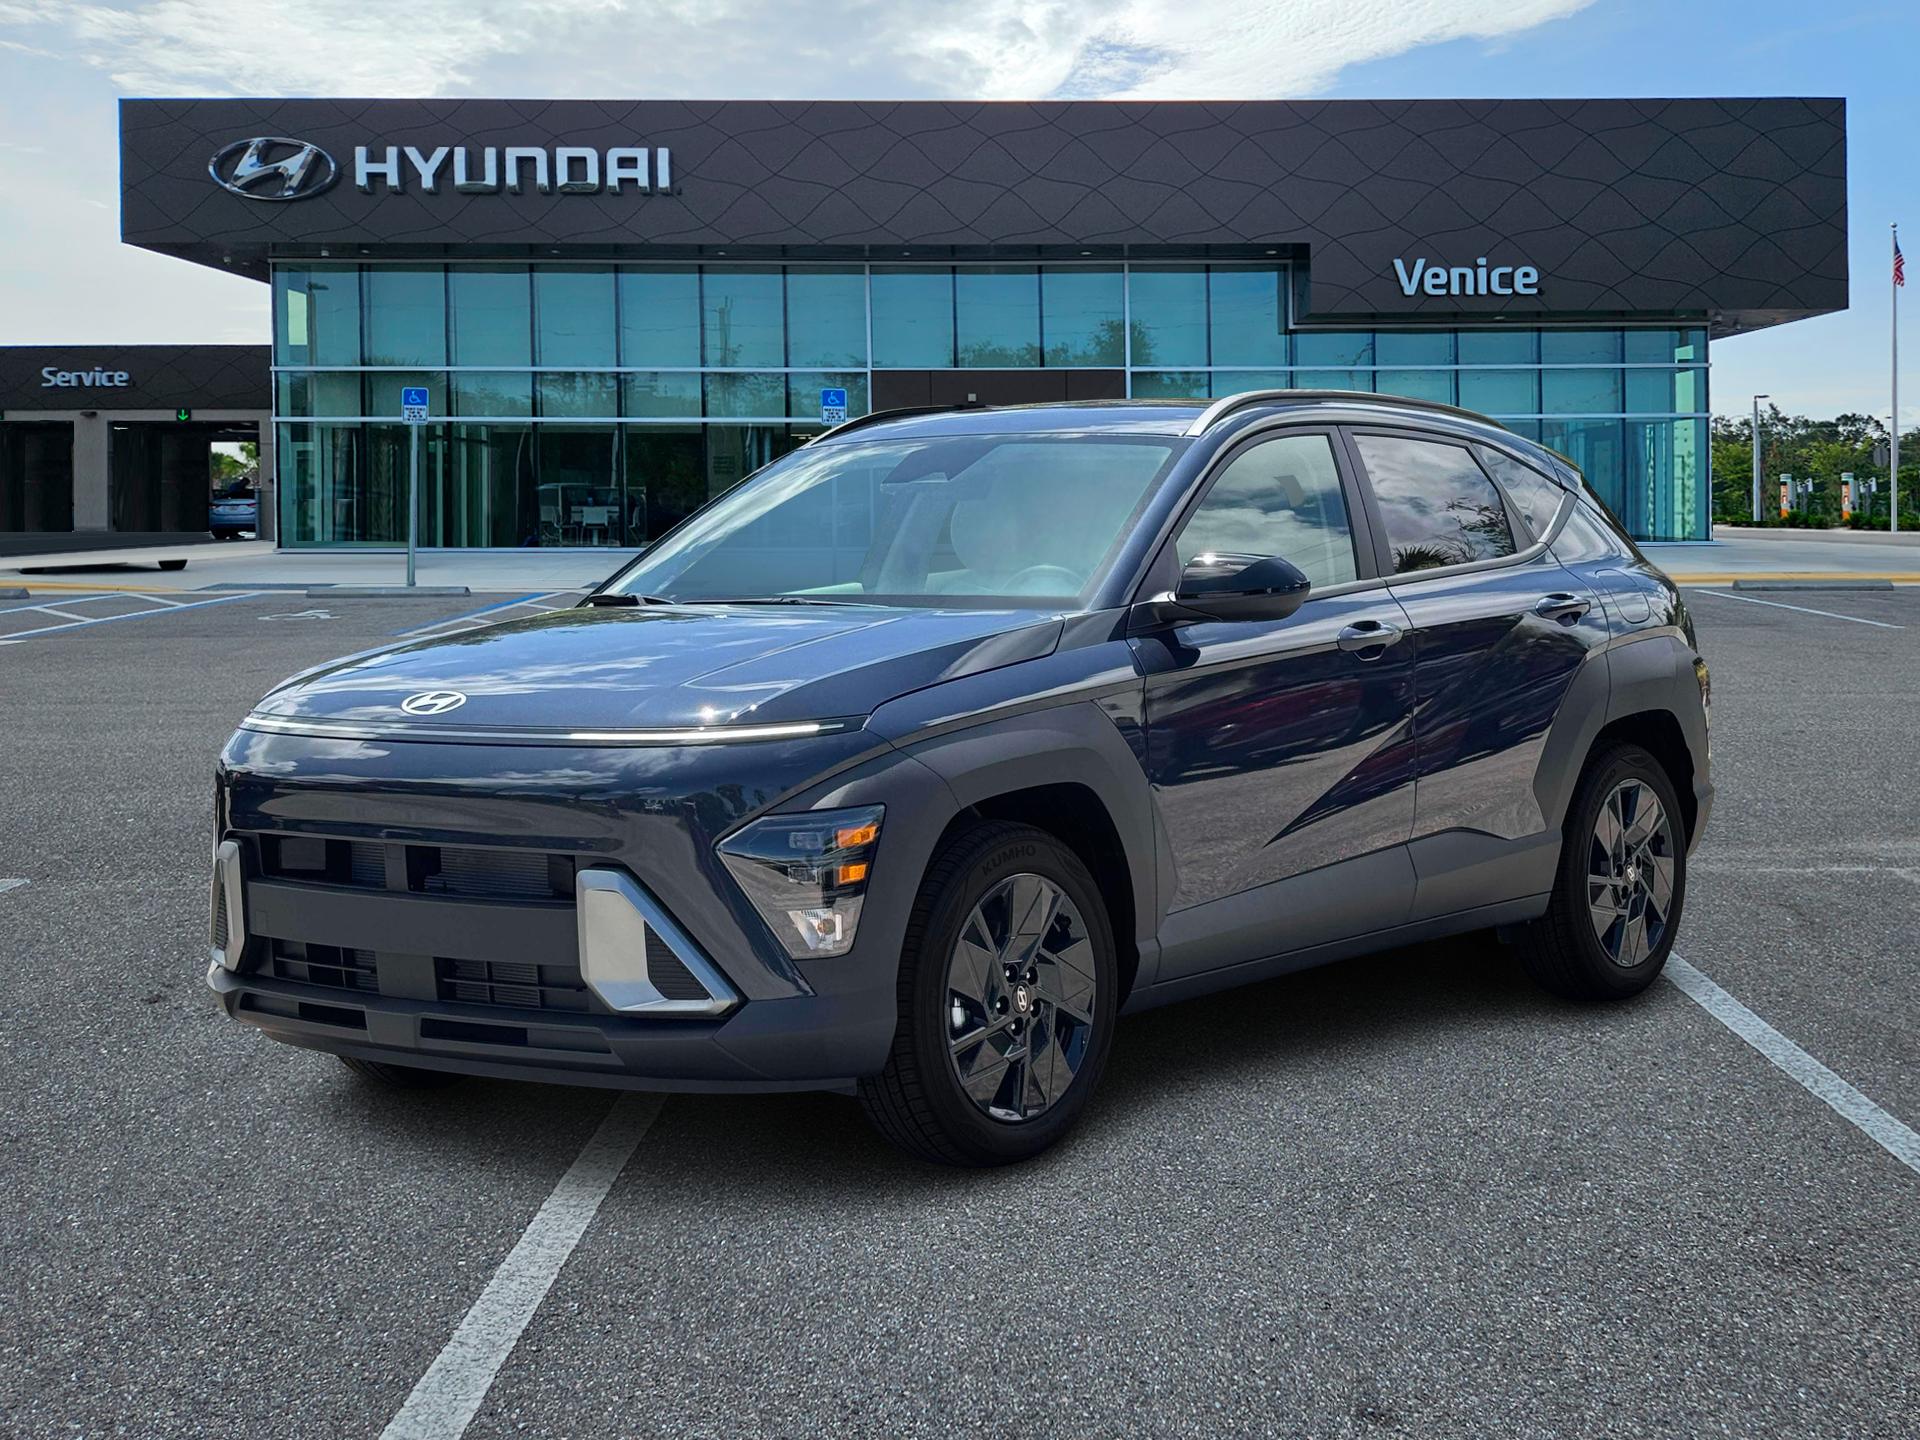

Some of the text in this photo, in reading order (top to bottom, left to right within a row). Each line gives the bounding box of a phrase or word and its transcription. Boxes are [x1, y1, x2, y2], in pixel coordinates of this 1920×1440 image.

[354, 146, 671, 193] HYUNDAI
[1392, 257, 1539, 296] Venice
[41, 367, 129, 387] Service
[982, 844, 1037, 876] KUMHO
